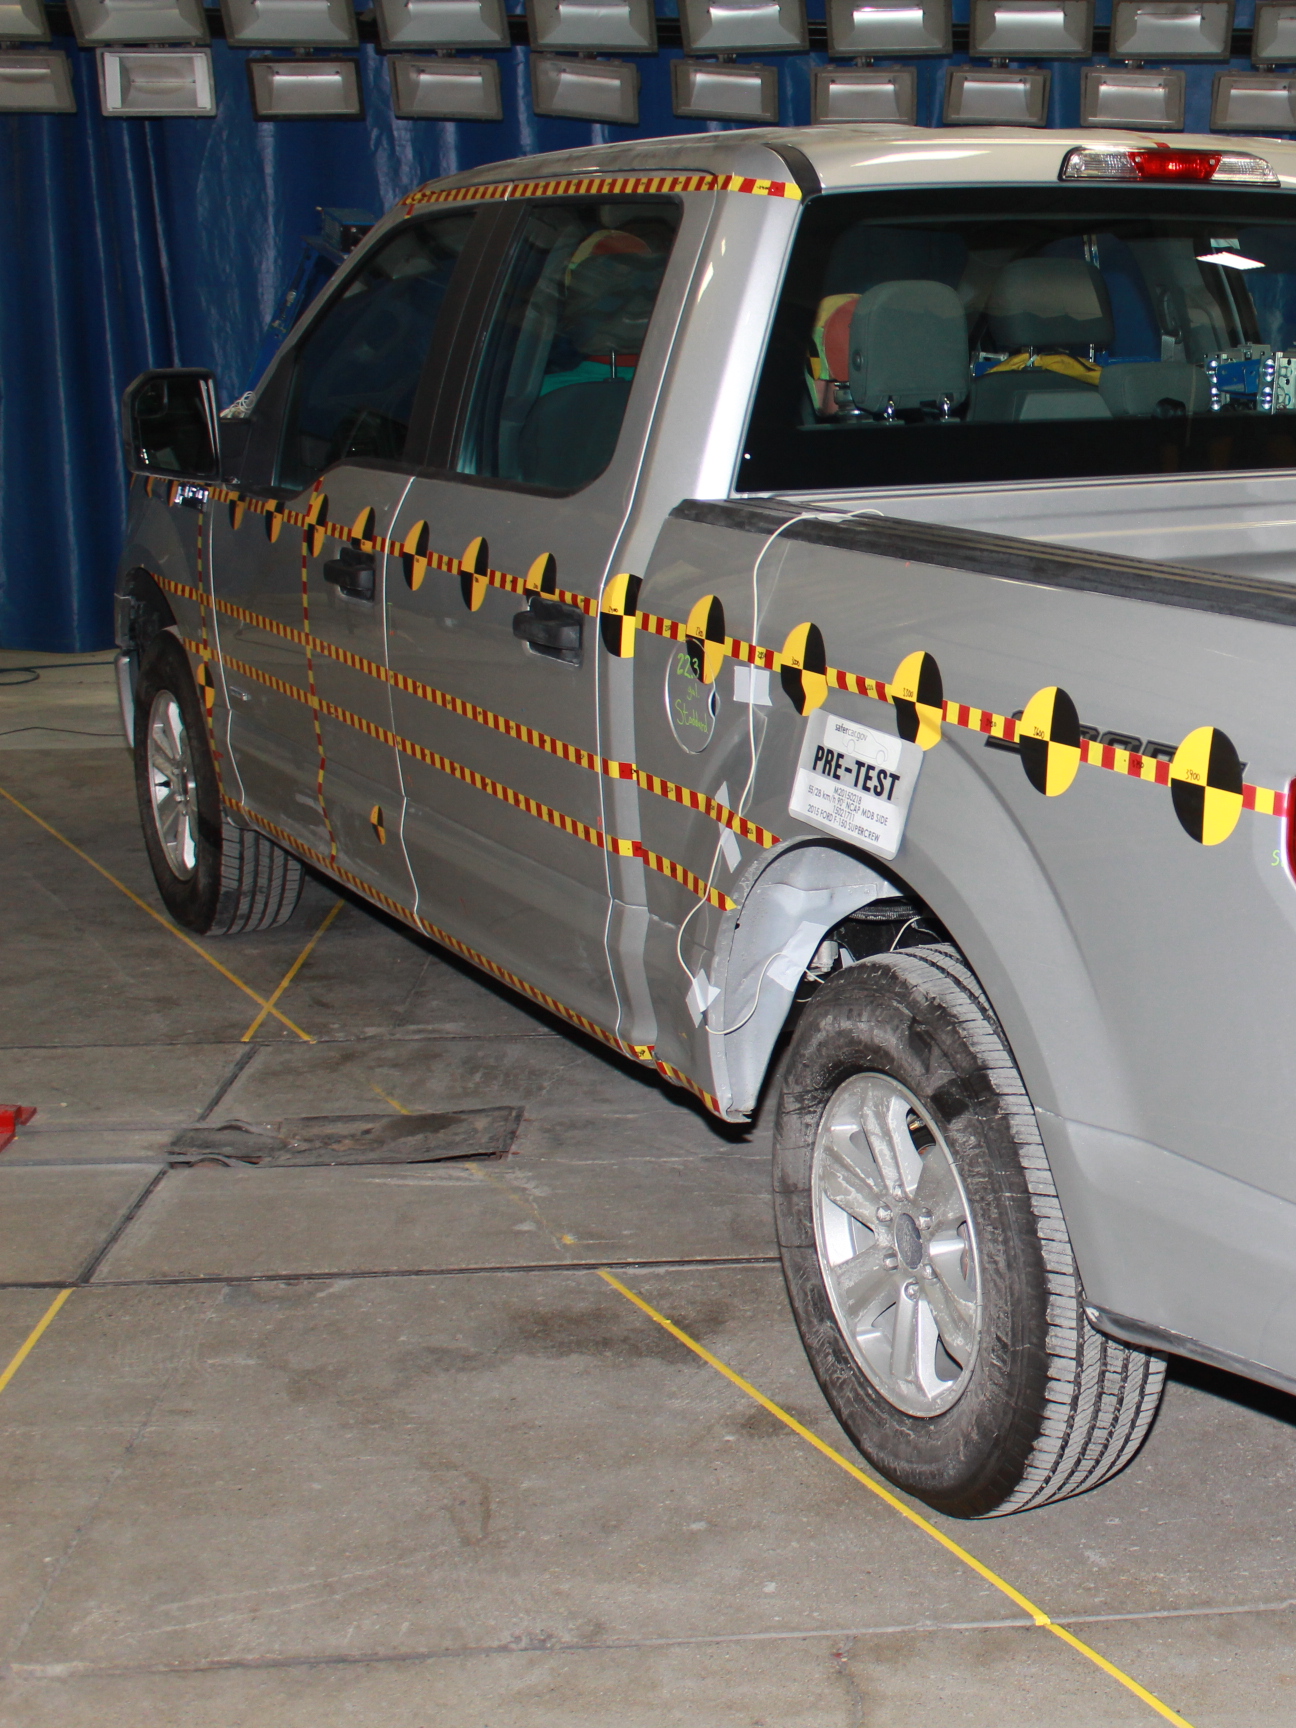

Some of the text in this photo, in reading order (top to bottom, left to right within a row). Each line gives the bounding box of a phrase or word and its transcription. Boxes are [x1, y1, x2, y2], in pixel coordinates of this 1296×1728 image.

[834, 723, 868, 742] safercar.gov
[812, 744, 901, 802] PRE-TEST
[1185, 768, 1201, 781] 3900
[807, 803, 820, 816] 2015
[819, 808, 834, 822] FORD
[847, 821, 881, 843] SUPERCREW
[845, 801, 861, 814] NCAP
[875, 813, 889, 826] SIDE
